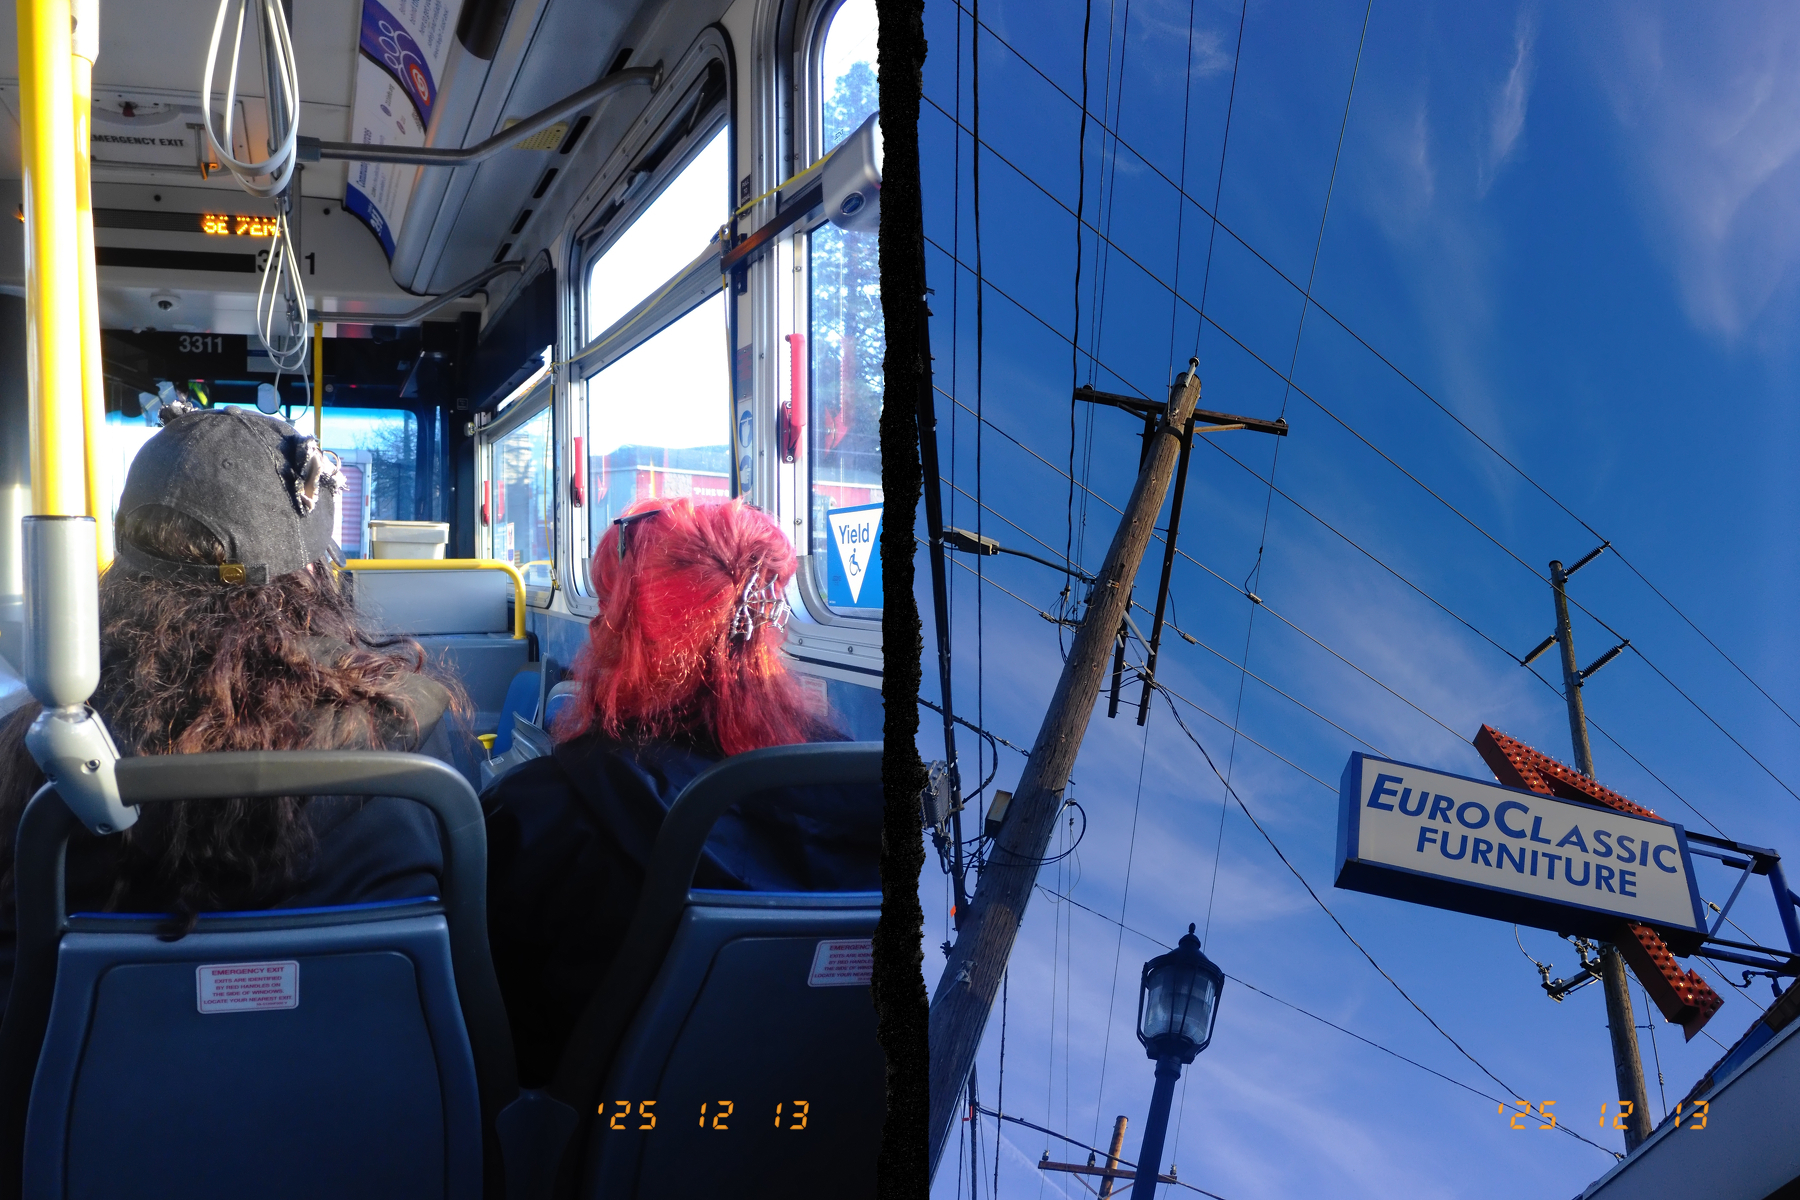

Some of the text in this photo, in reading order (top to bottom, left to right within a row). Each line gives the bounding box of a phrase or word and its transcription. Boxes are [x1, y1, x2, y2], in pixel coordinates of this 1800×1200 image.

[91, 134, 184, 147] MERGENCY EXIT
[203, 214, 281, 238] SE 72N
[257, 249, 315, 275] 31
[179, 335, 222, 353] 3311
[838, 522, 870, 545] Yield
[1416, 825, 1637, 898] FURNITURE
[212, 968, 264, 976] EMERGENCY
